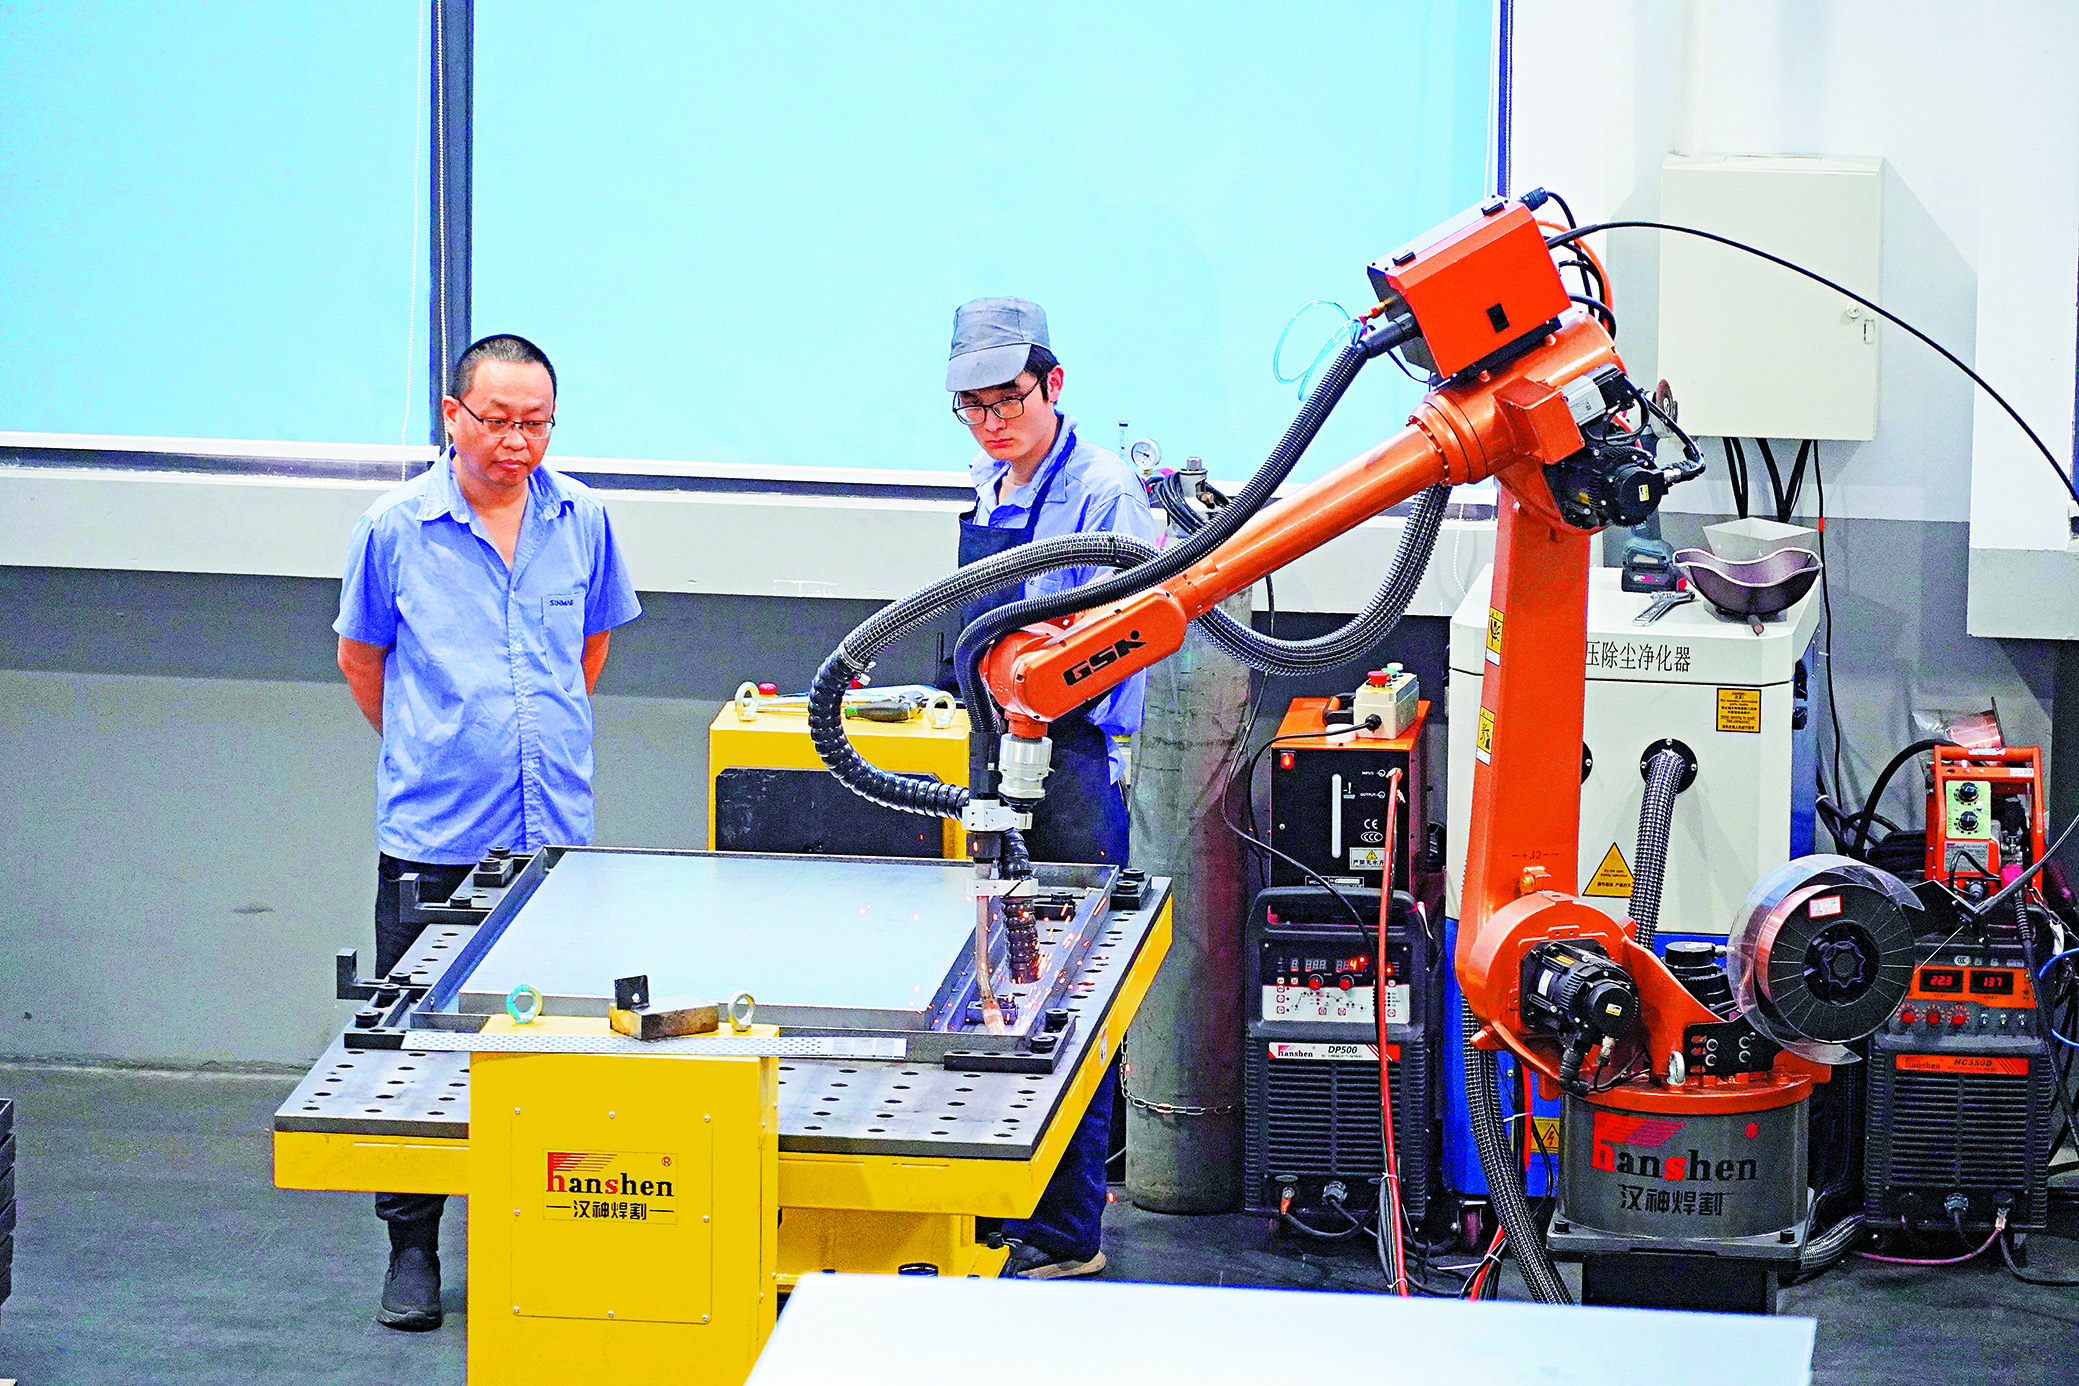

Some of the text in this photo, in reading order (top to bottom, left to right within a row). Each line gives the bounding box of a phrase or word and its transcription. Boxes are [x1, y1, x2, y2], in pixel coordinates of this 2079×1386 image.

[1327, 1045, 1358, 1054] DP500
[1591, 1110, 1758, 1181] hanshen
[546, 1151, 674, 1197] hanshen
[573, 1200, 647, 1220] 汉神焊割
[1617, 1183, 1723, 1216] 汉神焊割
